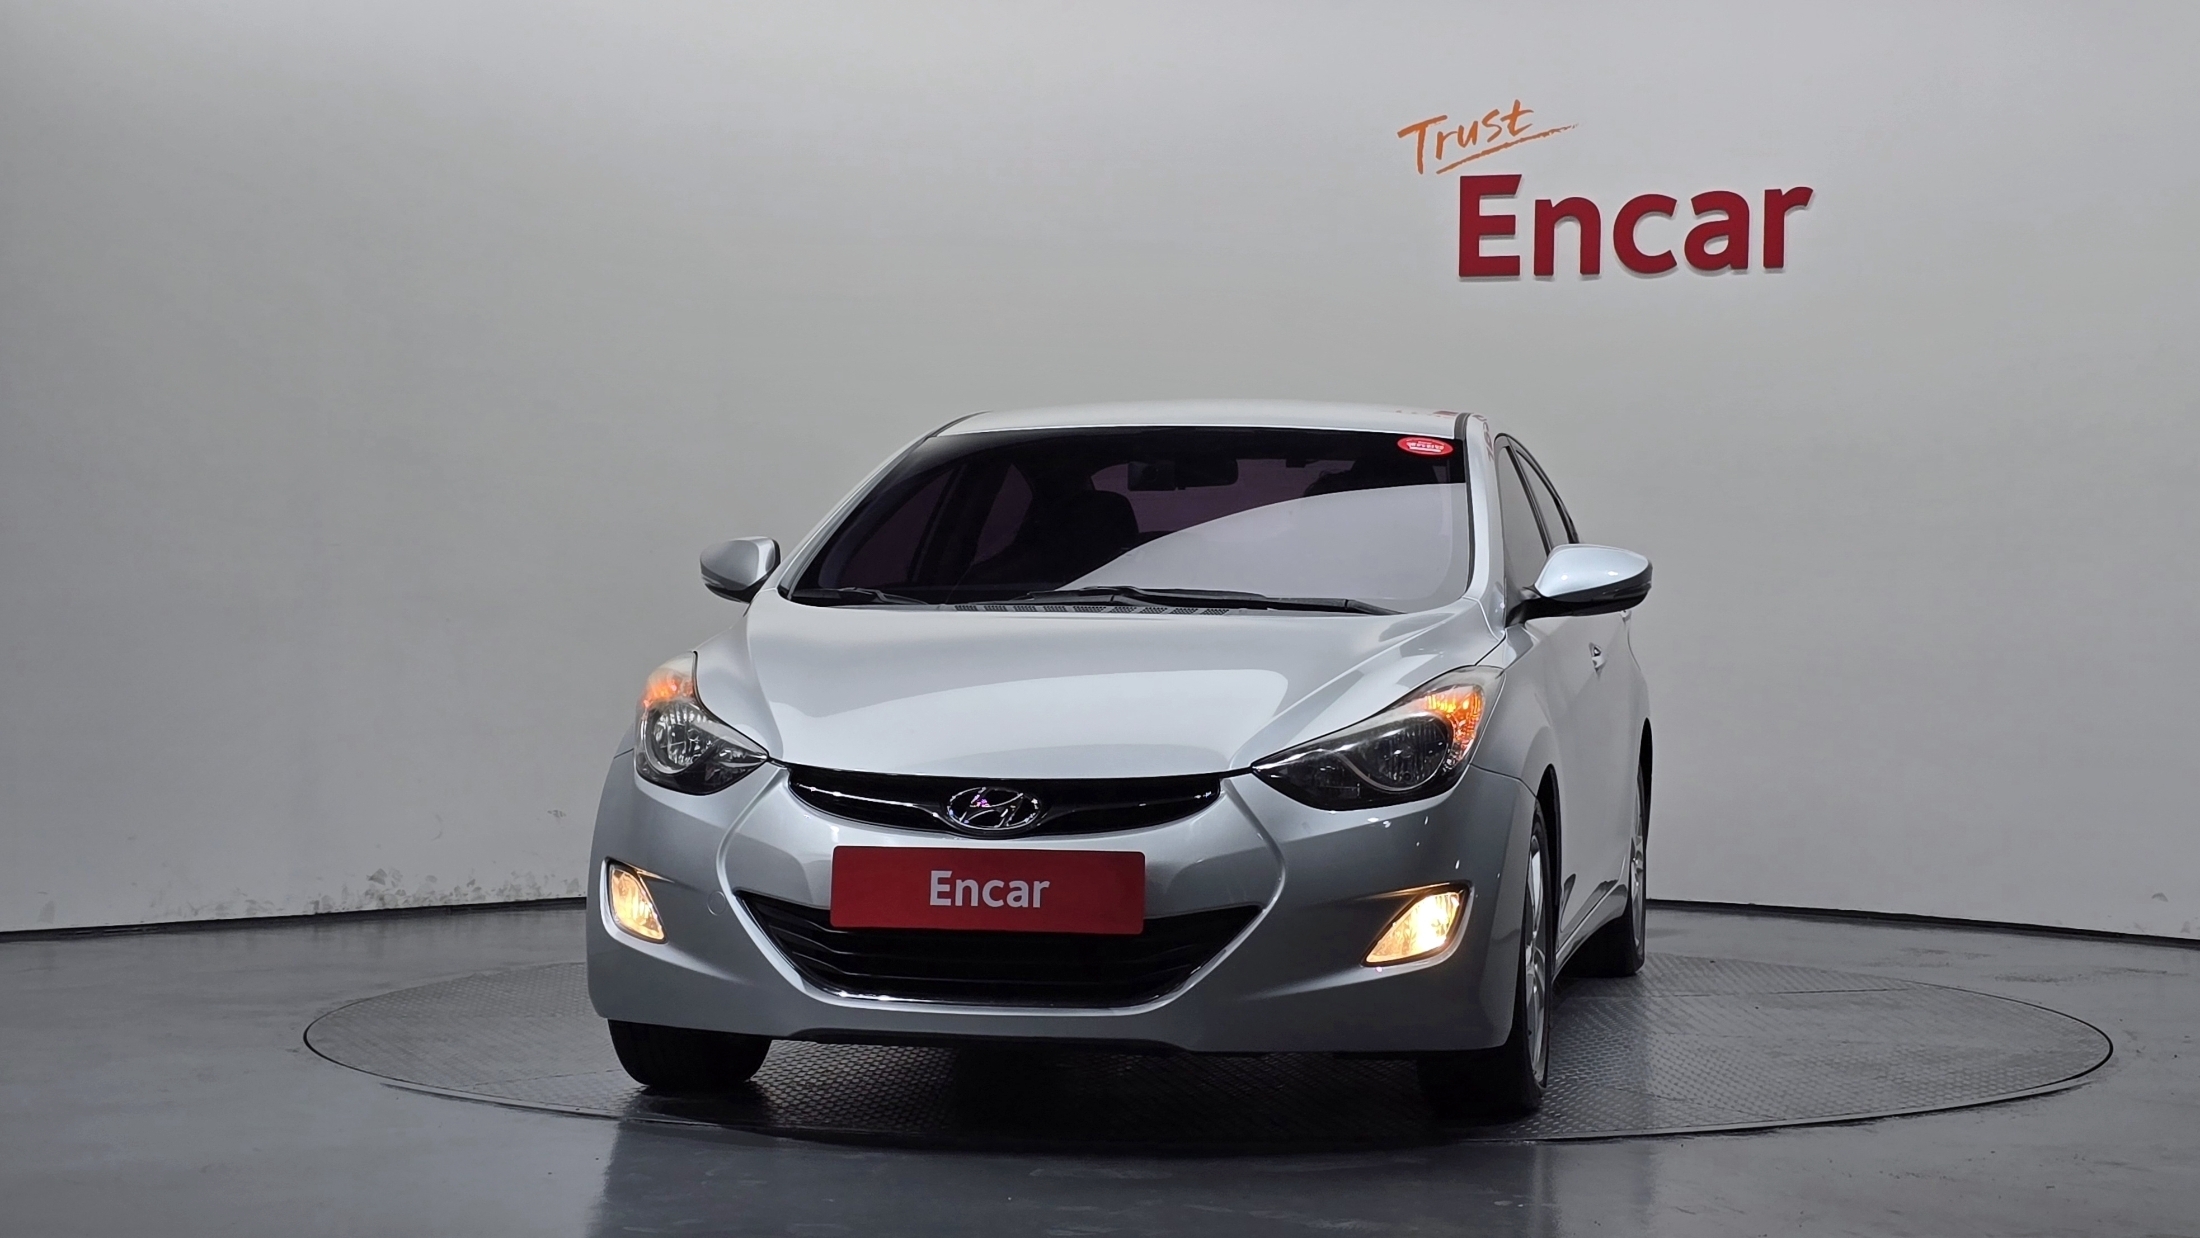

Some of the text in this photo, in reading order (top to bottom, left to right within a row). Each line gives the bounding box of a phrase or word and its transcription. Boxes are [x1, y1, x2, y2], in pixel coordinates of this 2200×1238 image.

[1397, 99, 1535, 174] Trust
[1458, 174, 1814, 277] Encar
[929, 869, 1050, 908] Encar
